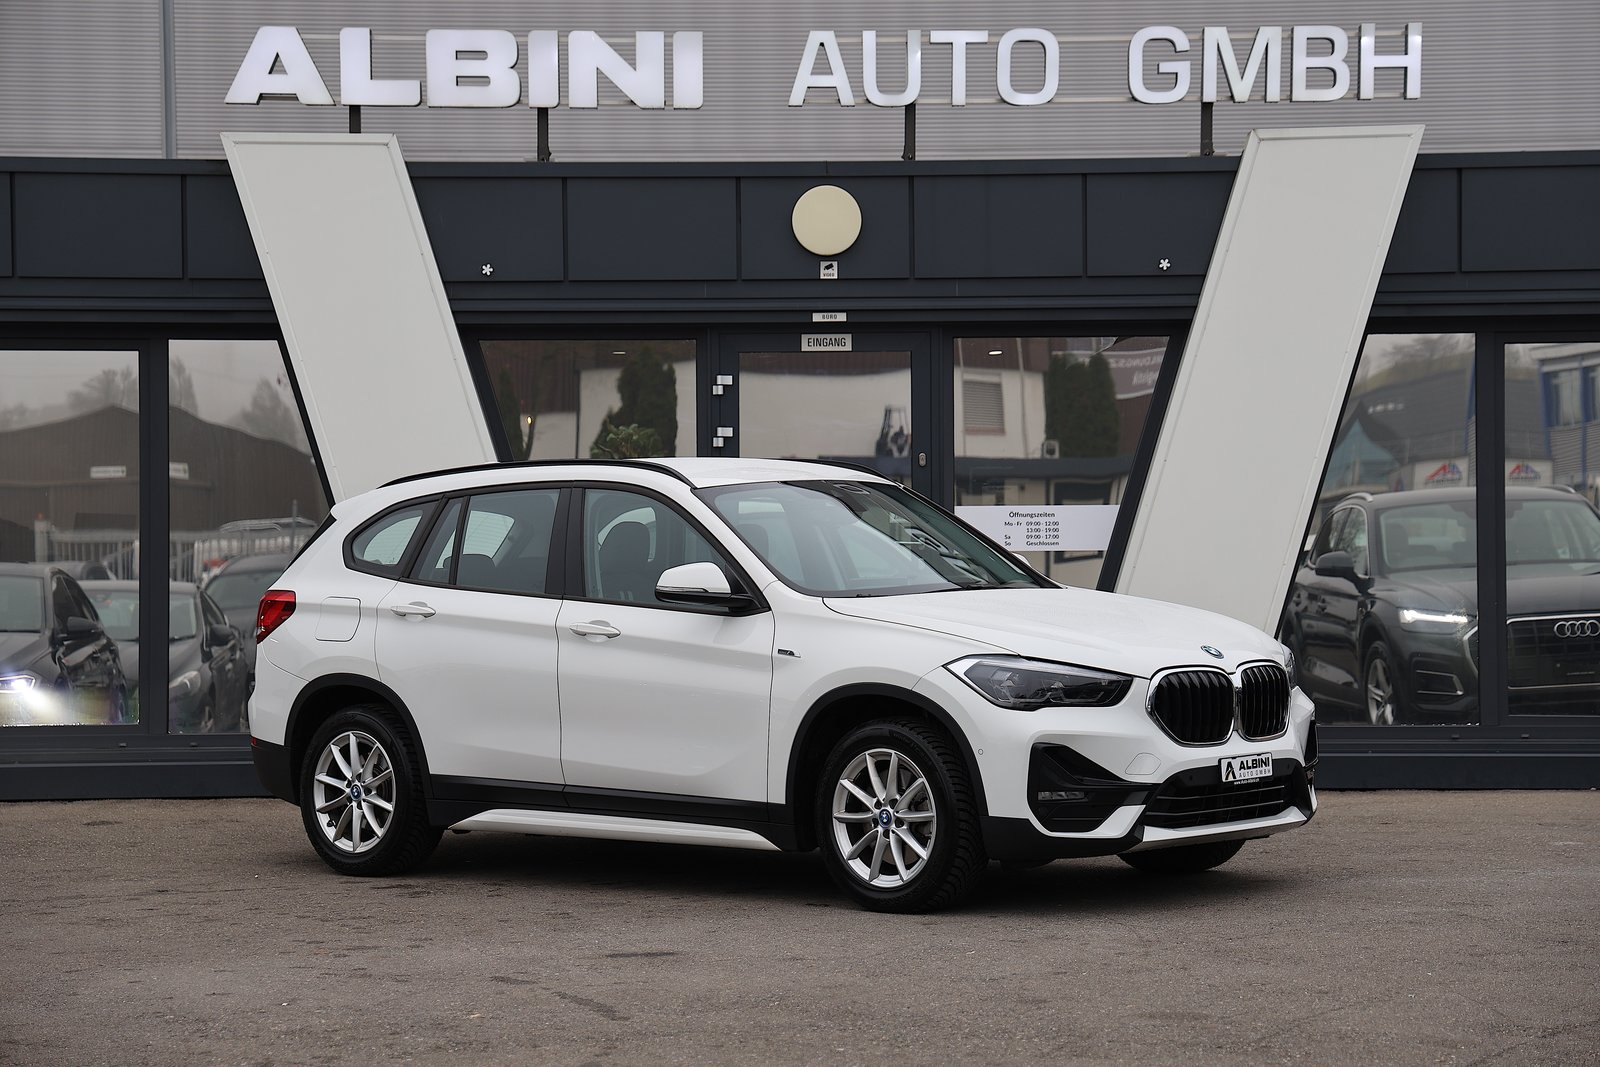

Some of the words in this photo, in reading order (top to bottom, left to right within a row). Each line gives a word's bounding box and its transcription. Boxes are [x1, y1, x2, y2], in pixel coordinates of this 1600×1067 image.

[224, 26, 703, 109] ALBINI
[788, 27, 1060, 108] AUTO
[1128, 22, 1423, 105] GMBH
[807, 337, 846, 347] EINGANG
[1008, 511, 1056, 519] Öffnungszeiten
[1239, 756, 1270, 771] ALBINI
[1239, 770, 1254, 778] AUTO
[1255, 768, 1271, 776] GMBH
